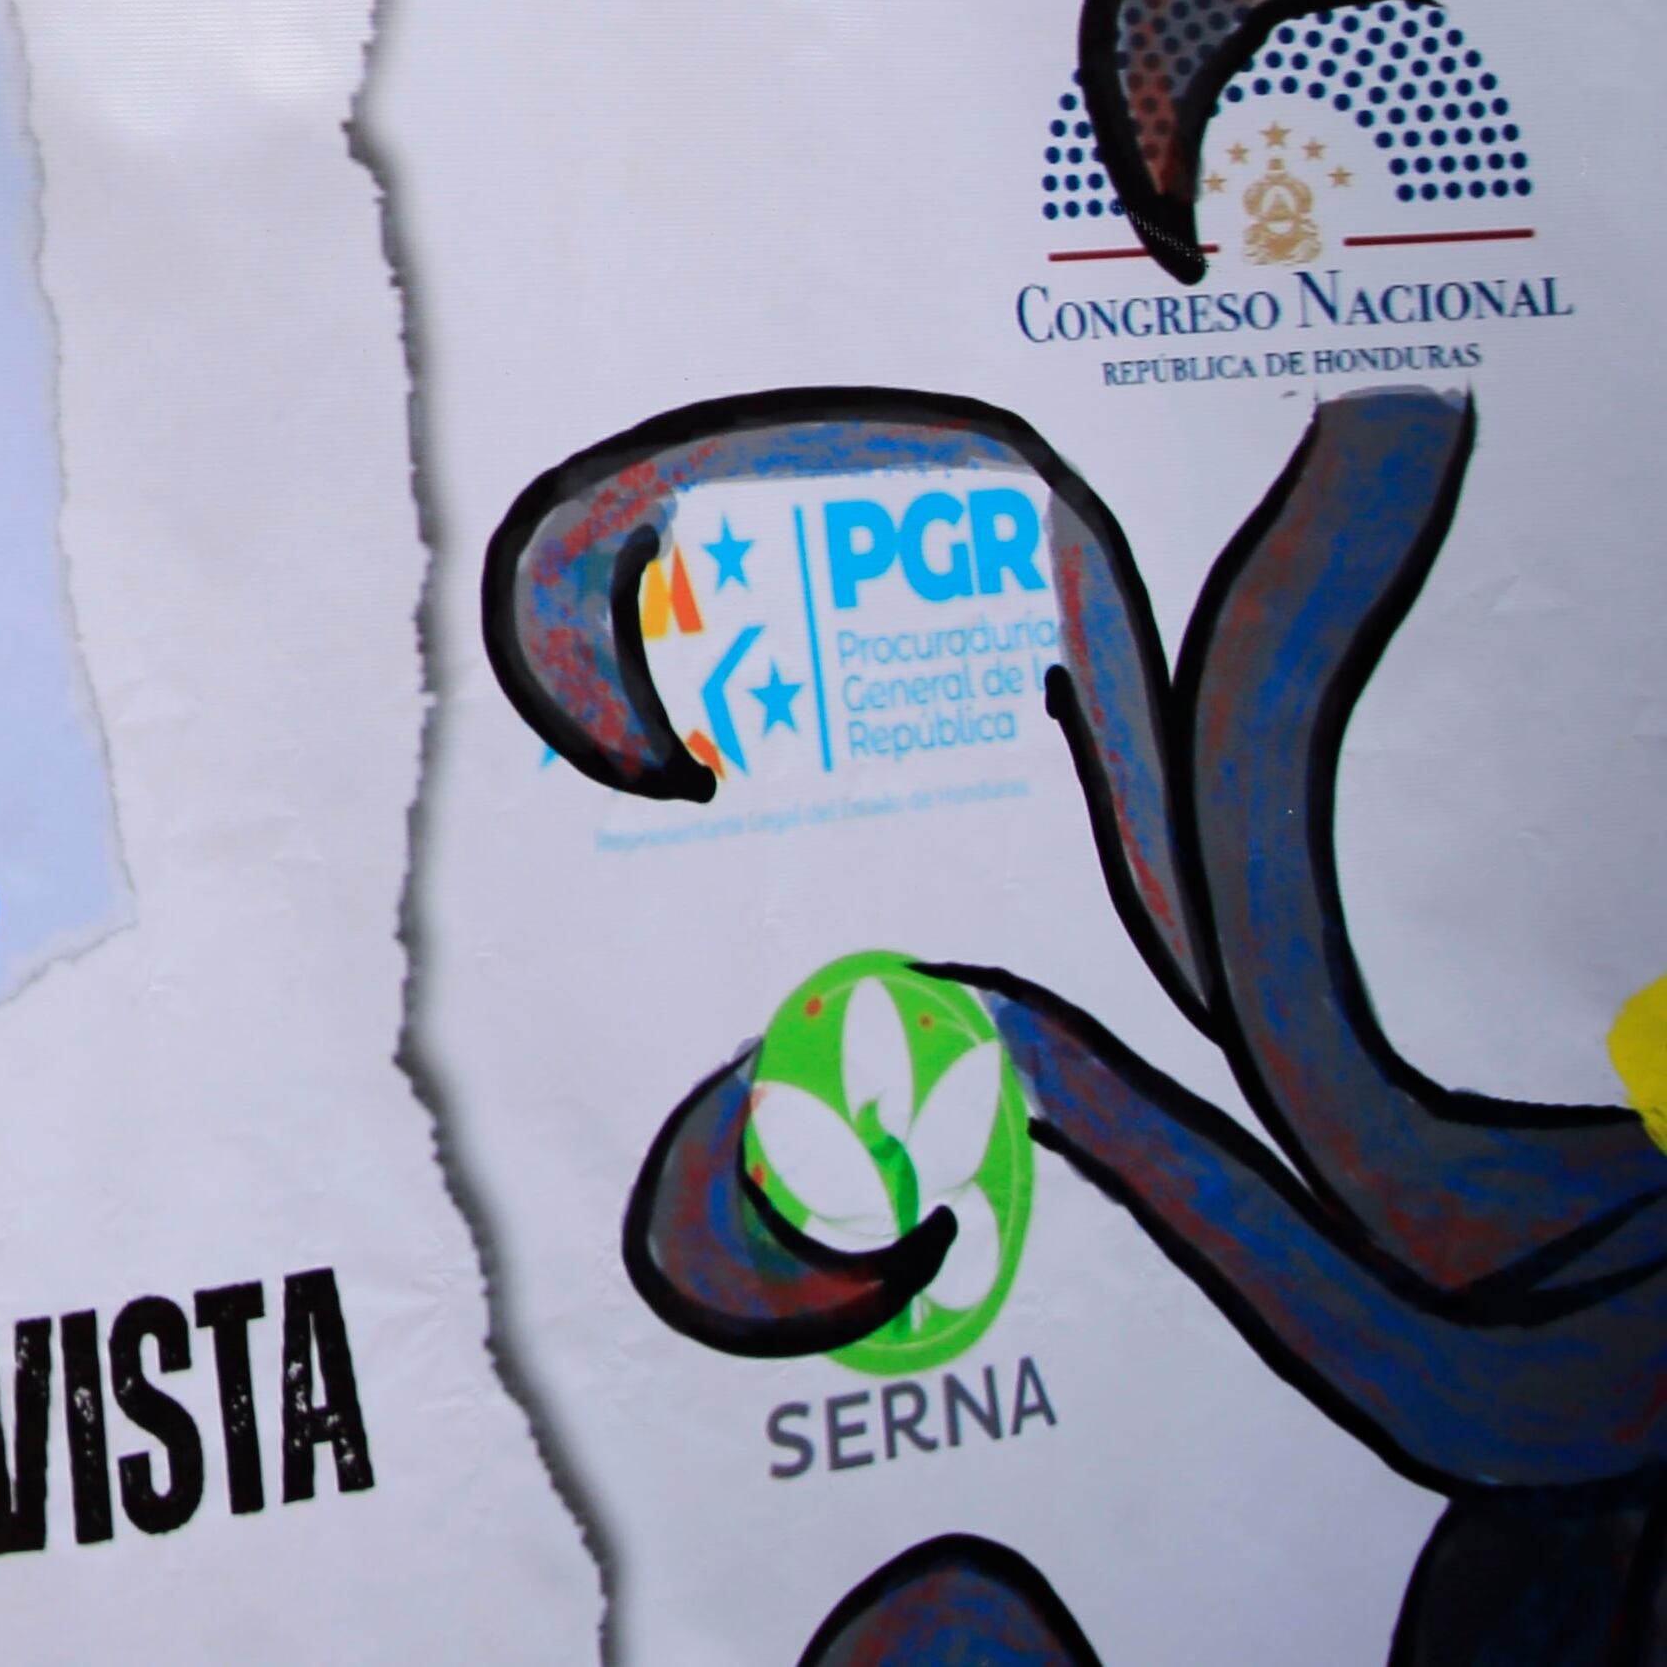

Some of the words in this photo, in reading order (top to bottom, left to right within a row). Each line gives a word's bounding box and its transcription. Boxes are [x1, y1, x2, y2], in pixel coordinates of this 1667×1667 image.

[1264, 350, 1307, 378] DE
[1313, 341, 1484, 376] HONDURAS
[822, 487, 1049, 611] PGR
[842, 661, 976, 713] General
[982, 657, 1025, 697] de
[765, 1354, 1059, 1480] SERNA
